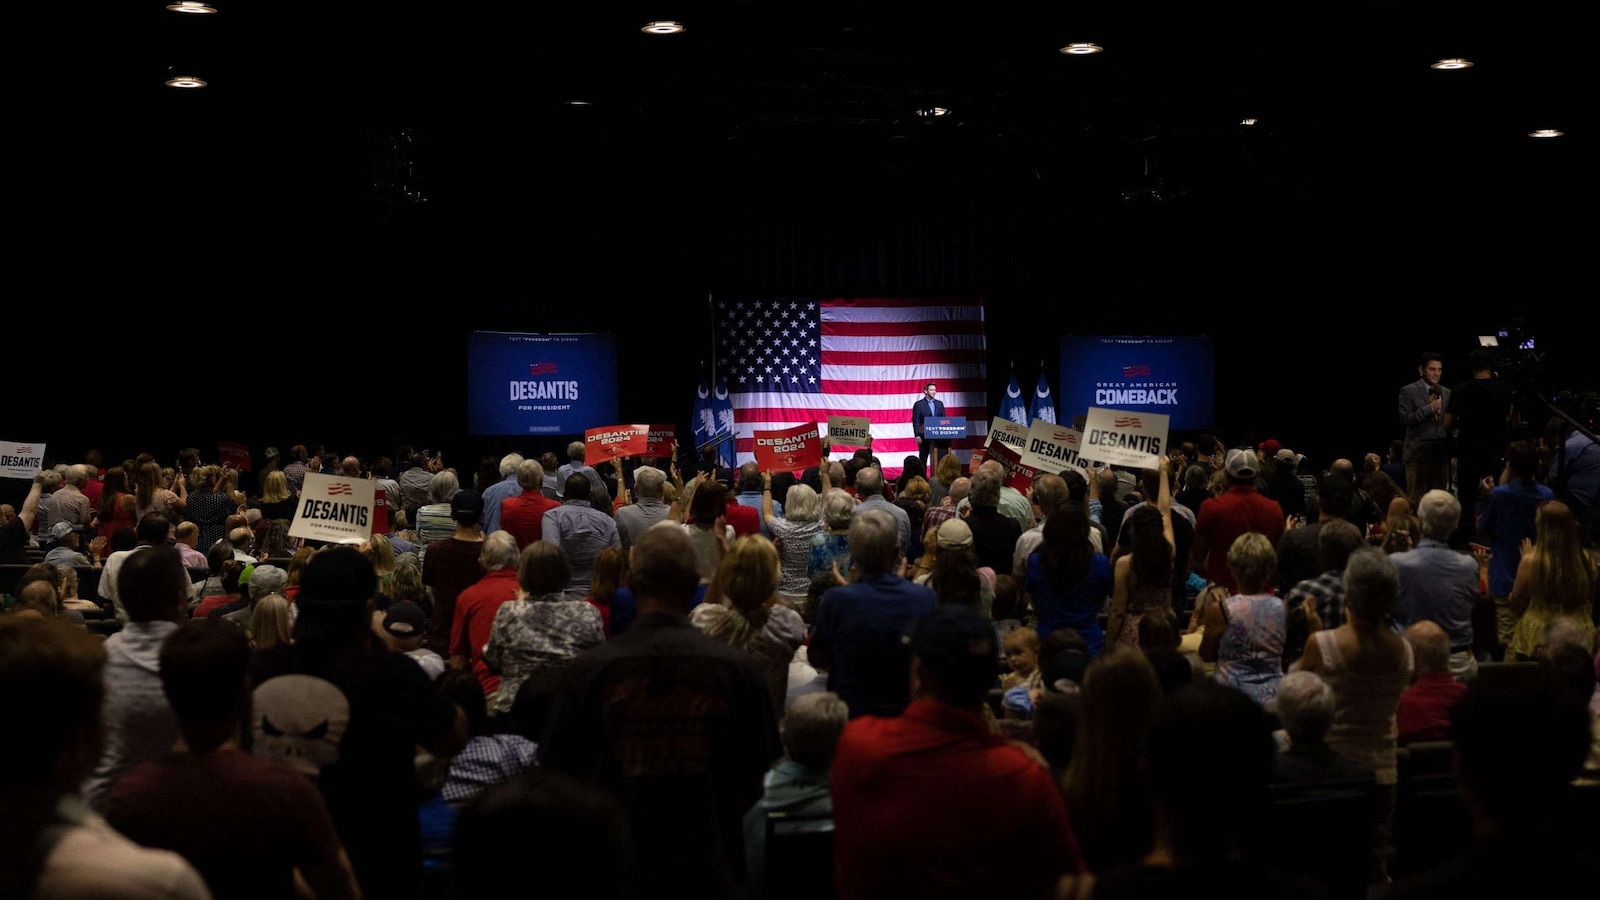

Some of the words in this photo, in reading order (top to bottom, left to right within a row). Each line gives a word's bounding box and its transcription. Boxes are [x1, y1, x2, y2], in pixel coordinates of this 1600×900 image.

[510, 381, 578, 401] DESANTIS
[1096, 389, 1178, 405] COMEBACK
[588, 430, 648, 442] DESANTIS
[601, 437, 631, 445] 2024
[757, 430, 818, 446] DESANTIS
[830, 427, 866, 439] DESANTIS
[992, 429, 1027, 448] DESANTIS
[774, 442, 806, 453] 2024
[1089, 429, 1161, 455] DESANTIS
[1, 455, 40, 468] DESANTIS
[1030, 438, 1089, 469] DESANTIS
[301, 499, 369, 527] DESANTIS
